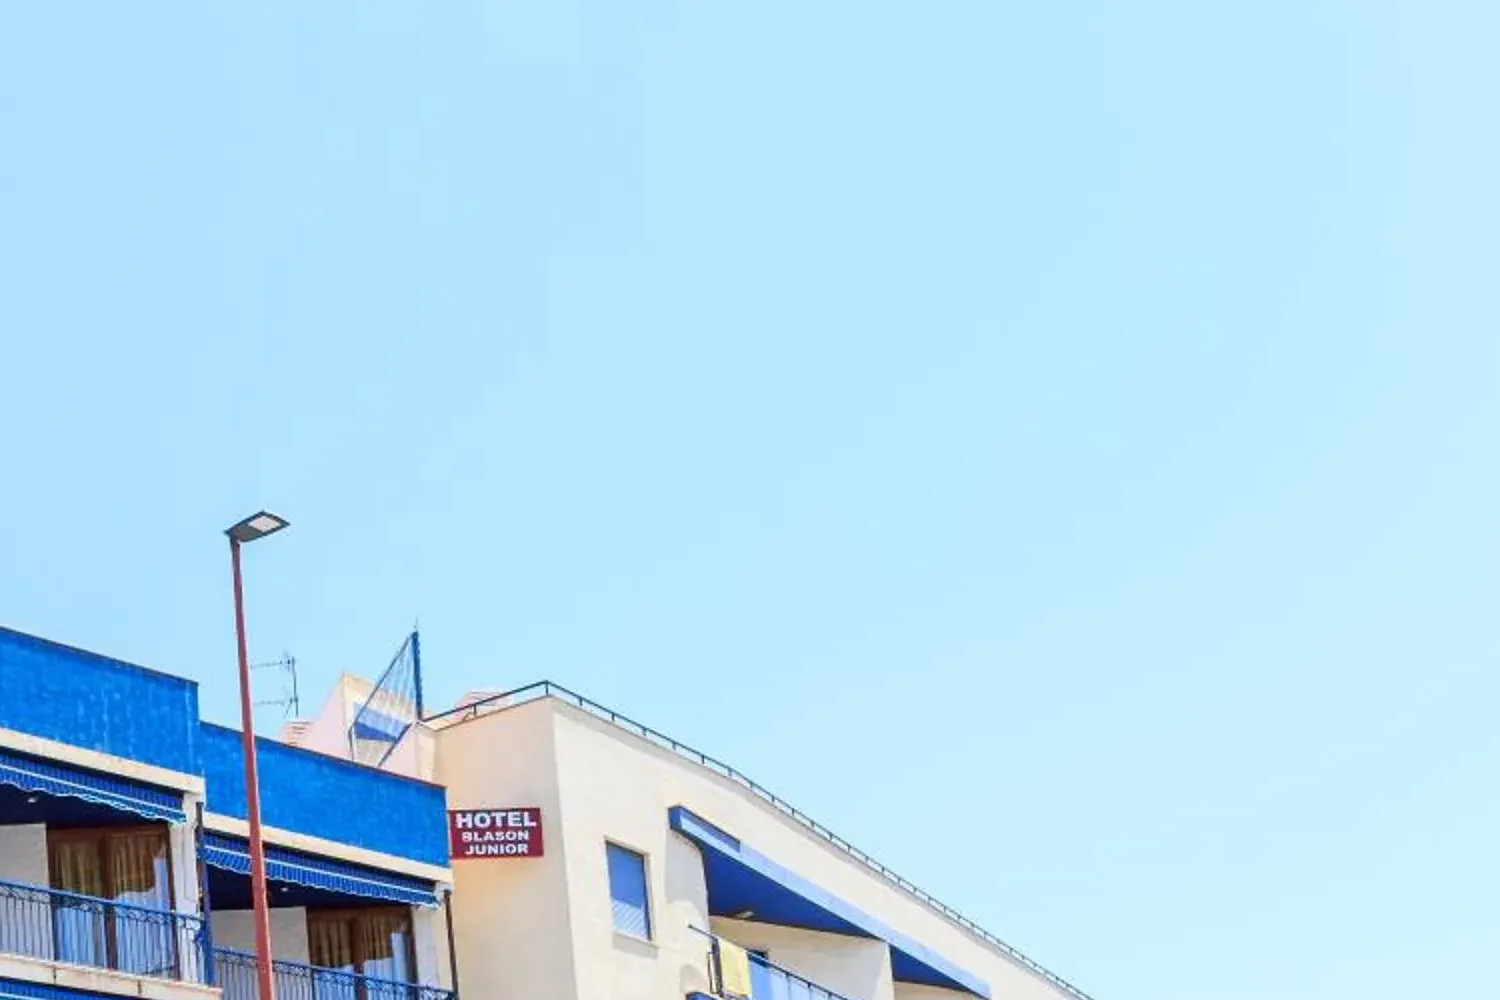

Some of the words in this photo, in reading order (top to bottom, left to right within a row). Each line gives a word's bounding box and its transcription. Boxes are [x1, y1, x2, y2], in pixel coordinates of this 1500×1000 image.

[456, 811, 537, 828] HOTEL
[462, 831, 529, 842] BLASON
[466, 844, 528, 855] JUNIOR
